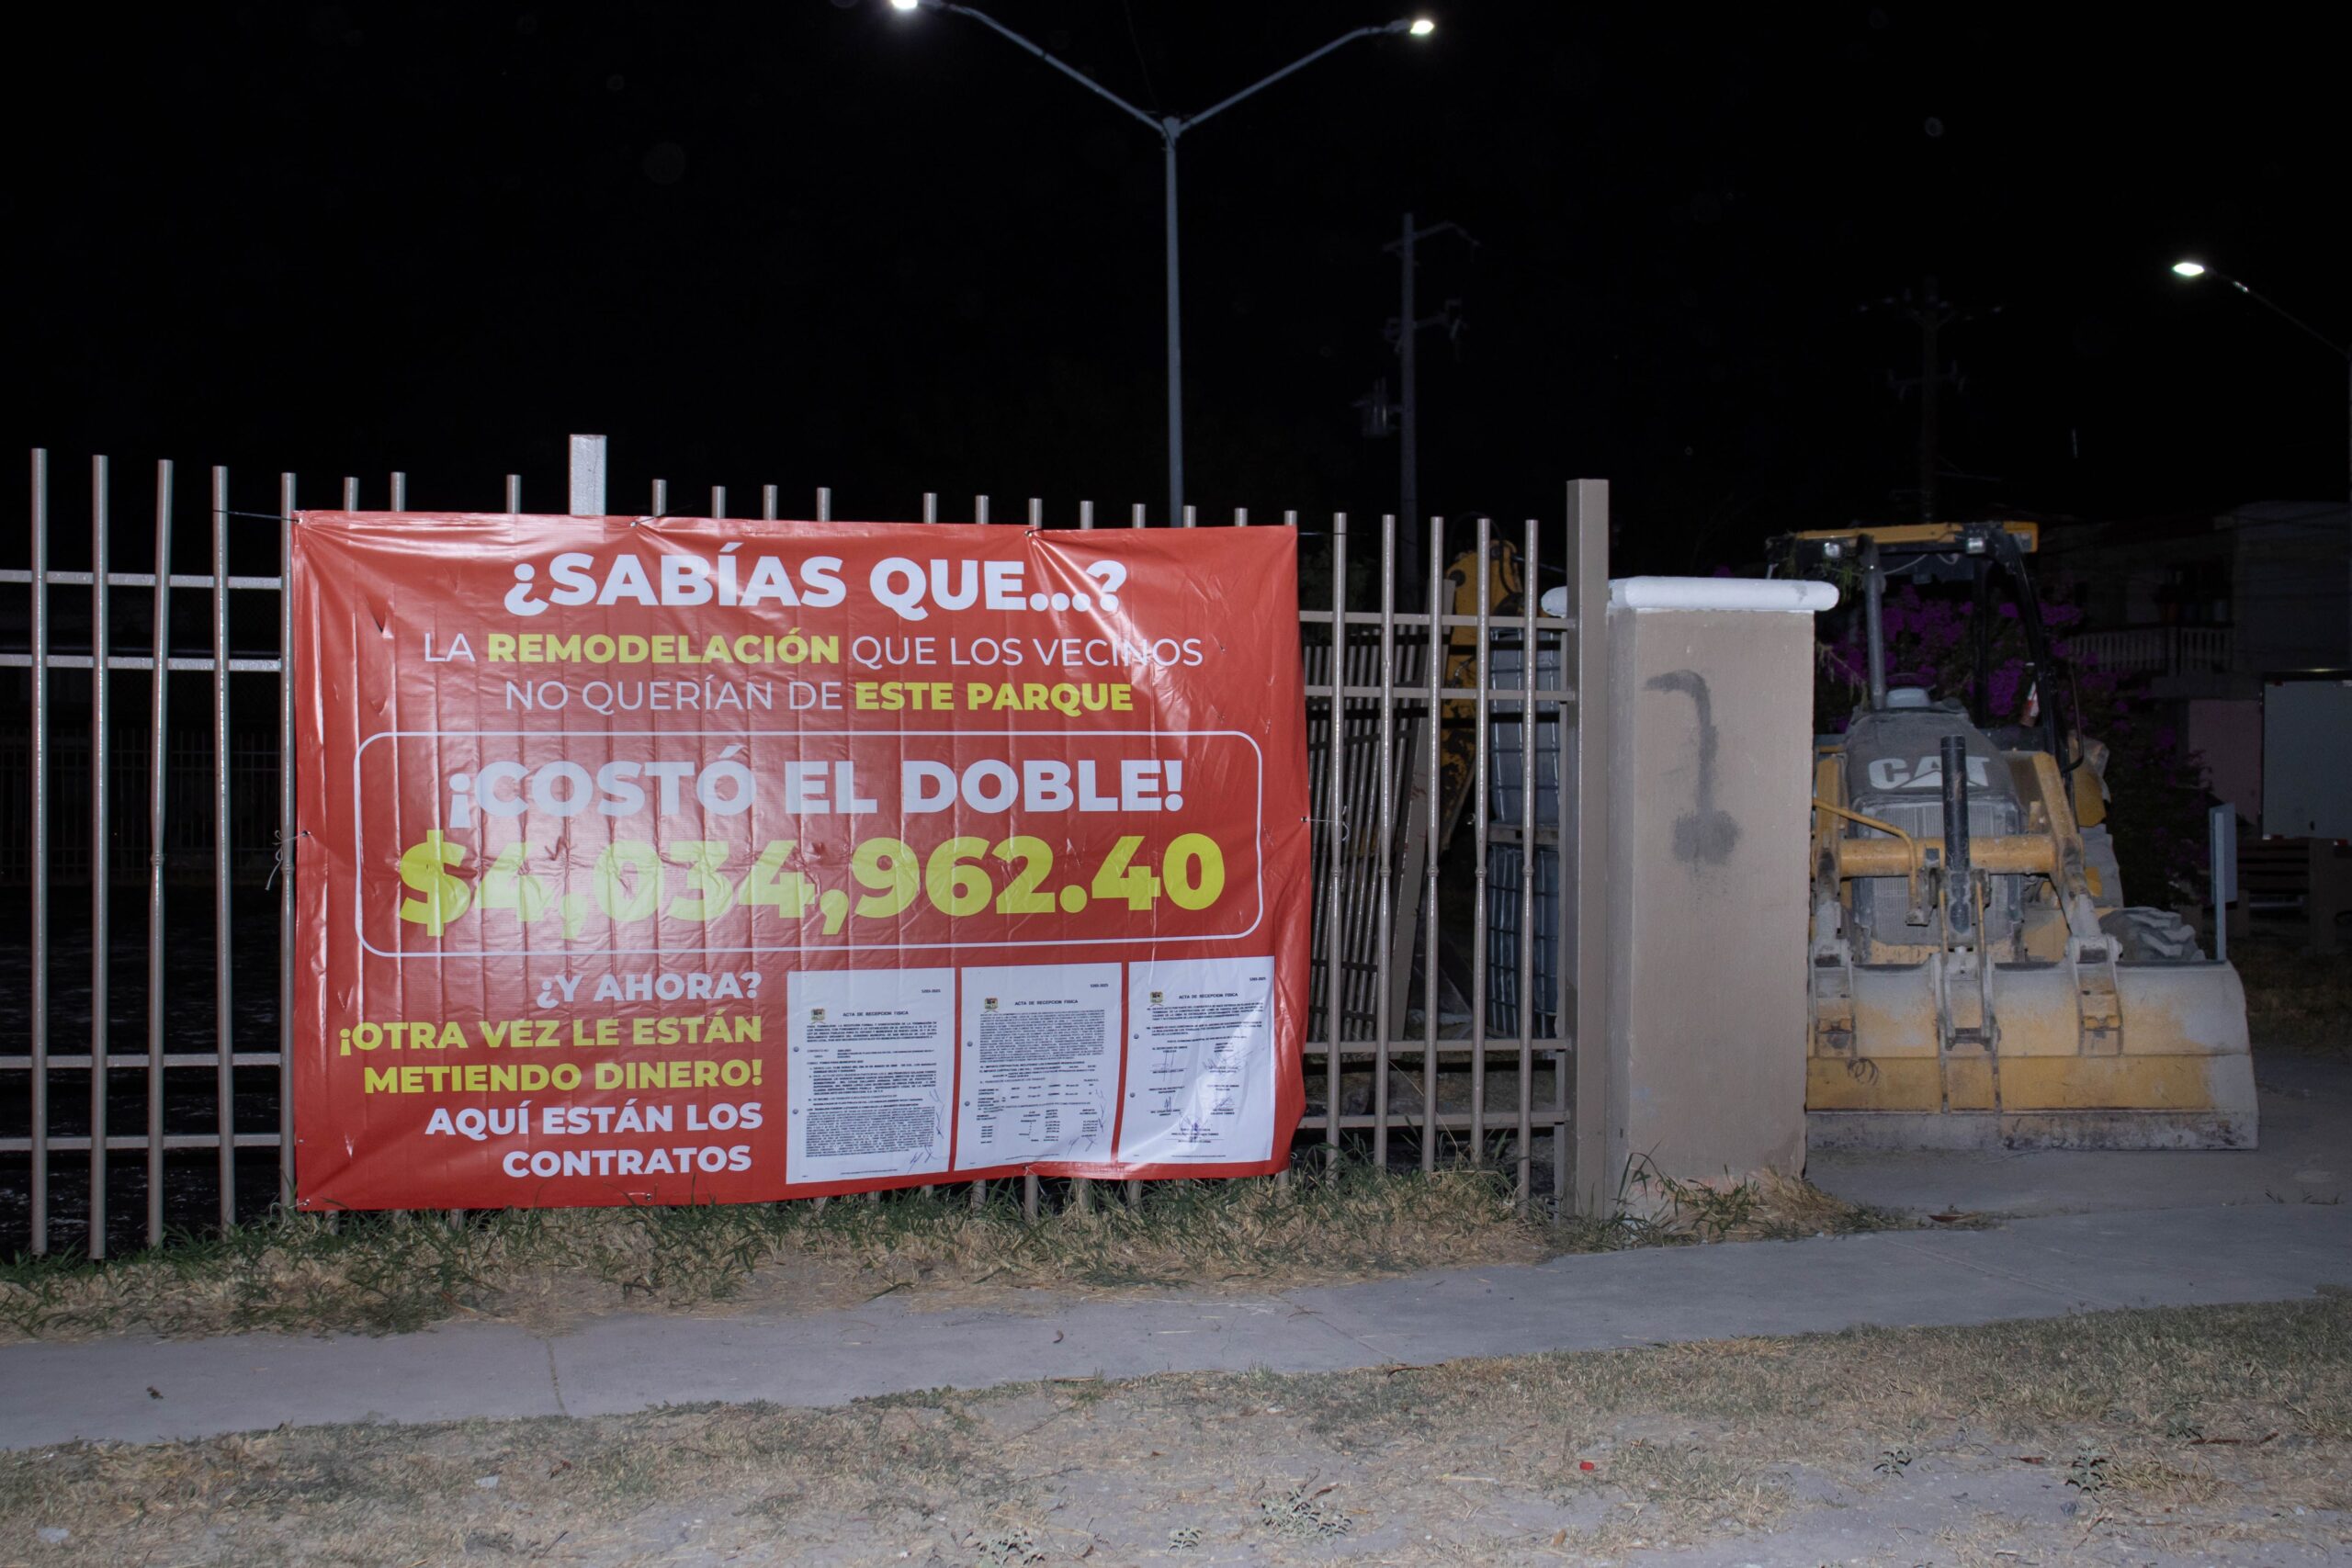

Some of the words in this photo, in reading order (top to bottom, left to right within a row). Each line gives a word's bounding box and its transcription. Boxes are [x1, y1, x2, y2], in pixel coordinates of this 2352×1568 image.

[503, 542, 847, 616] ¿SABÍAS
[869, 557, 1127, 621] QUE...?
[424, 632, 476, 662] LA
[488, 627, 840, 665] REMODELACIÓN
[852, 635, 936, 671] QUE
[950, 637, 1023, 667] LOS
[1033, 637, 1203, 667] VECINOS
[506, 680, 567, 711] NO
[582, 674, 772, 716] QUERÍAN
[789, 682, 843, 710] DE
[855, 681, 954, 711] ESTE
[967, 682, 1134, 716] PARQUE
[448, 745, 757, 829] ¡COSTÓ
[785, 760, 878, 815] EL
[902, 759, 1183, 815] DOBLE!
[1868, 755, 1990, 790] CAT
[399, 829, 1226, 940] $4,034,962.40
[537, 975, 585, 1009] ¿Y
[594, 972, 762, 1002] AHORA?
[339, 1021, 469, 1056] ¡OTRA
[479, 1019, 560, 1048] VEZ
[572, 1018, 619, 1046] LE
[632, 1009, 762, 1045] ESTÁN
[364, 1063, 582, 1094] METIENDO
[594, 1059, 763, 1090] DINERO!
[424, 1100, 530, 1141] AQUÍ
[542, 1098, 673, 1135] ESTÁN
[686, 1102, 763, 1132] LOS
[503, 1145, 752, 1178] CONTRATOS
